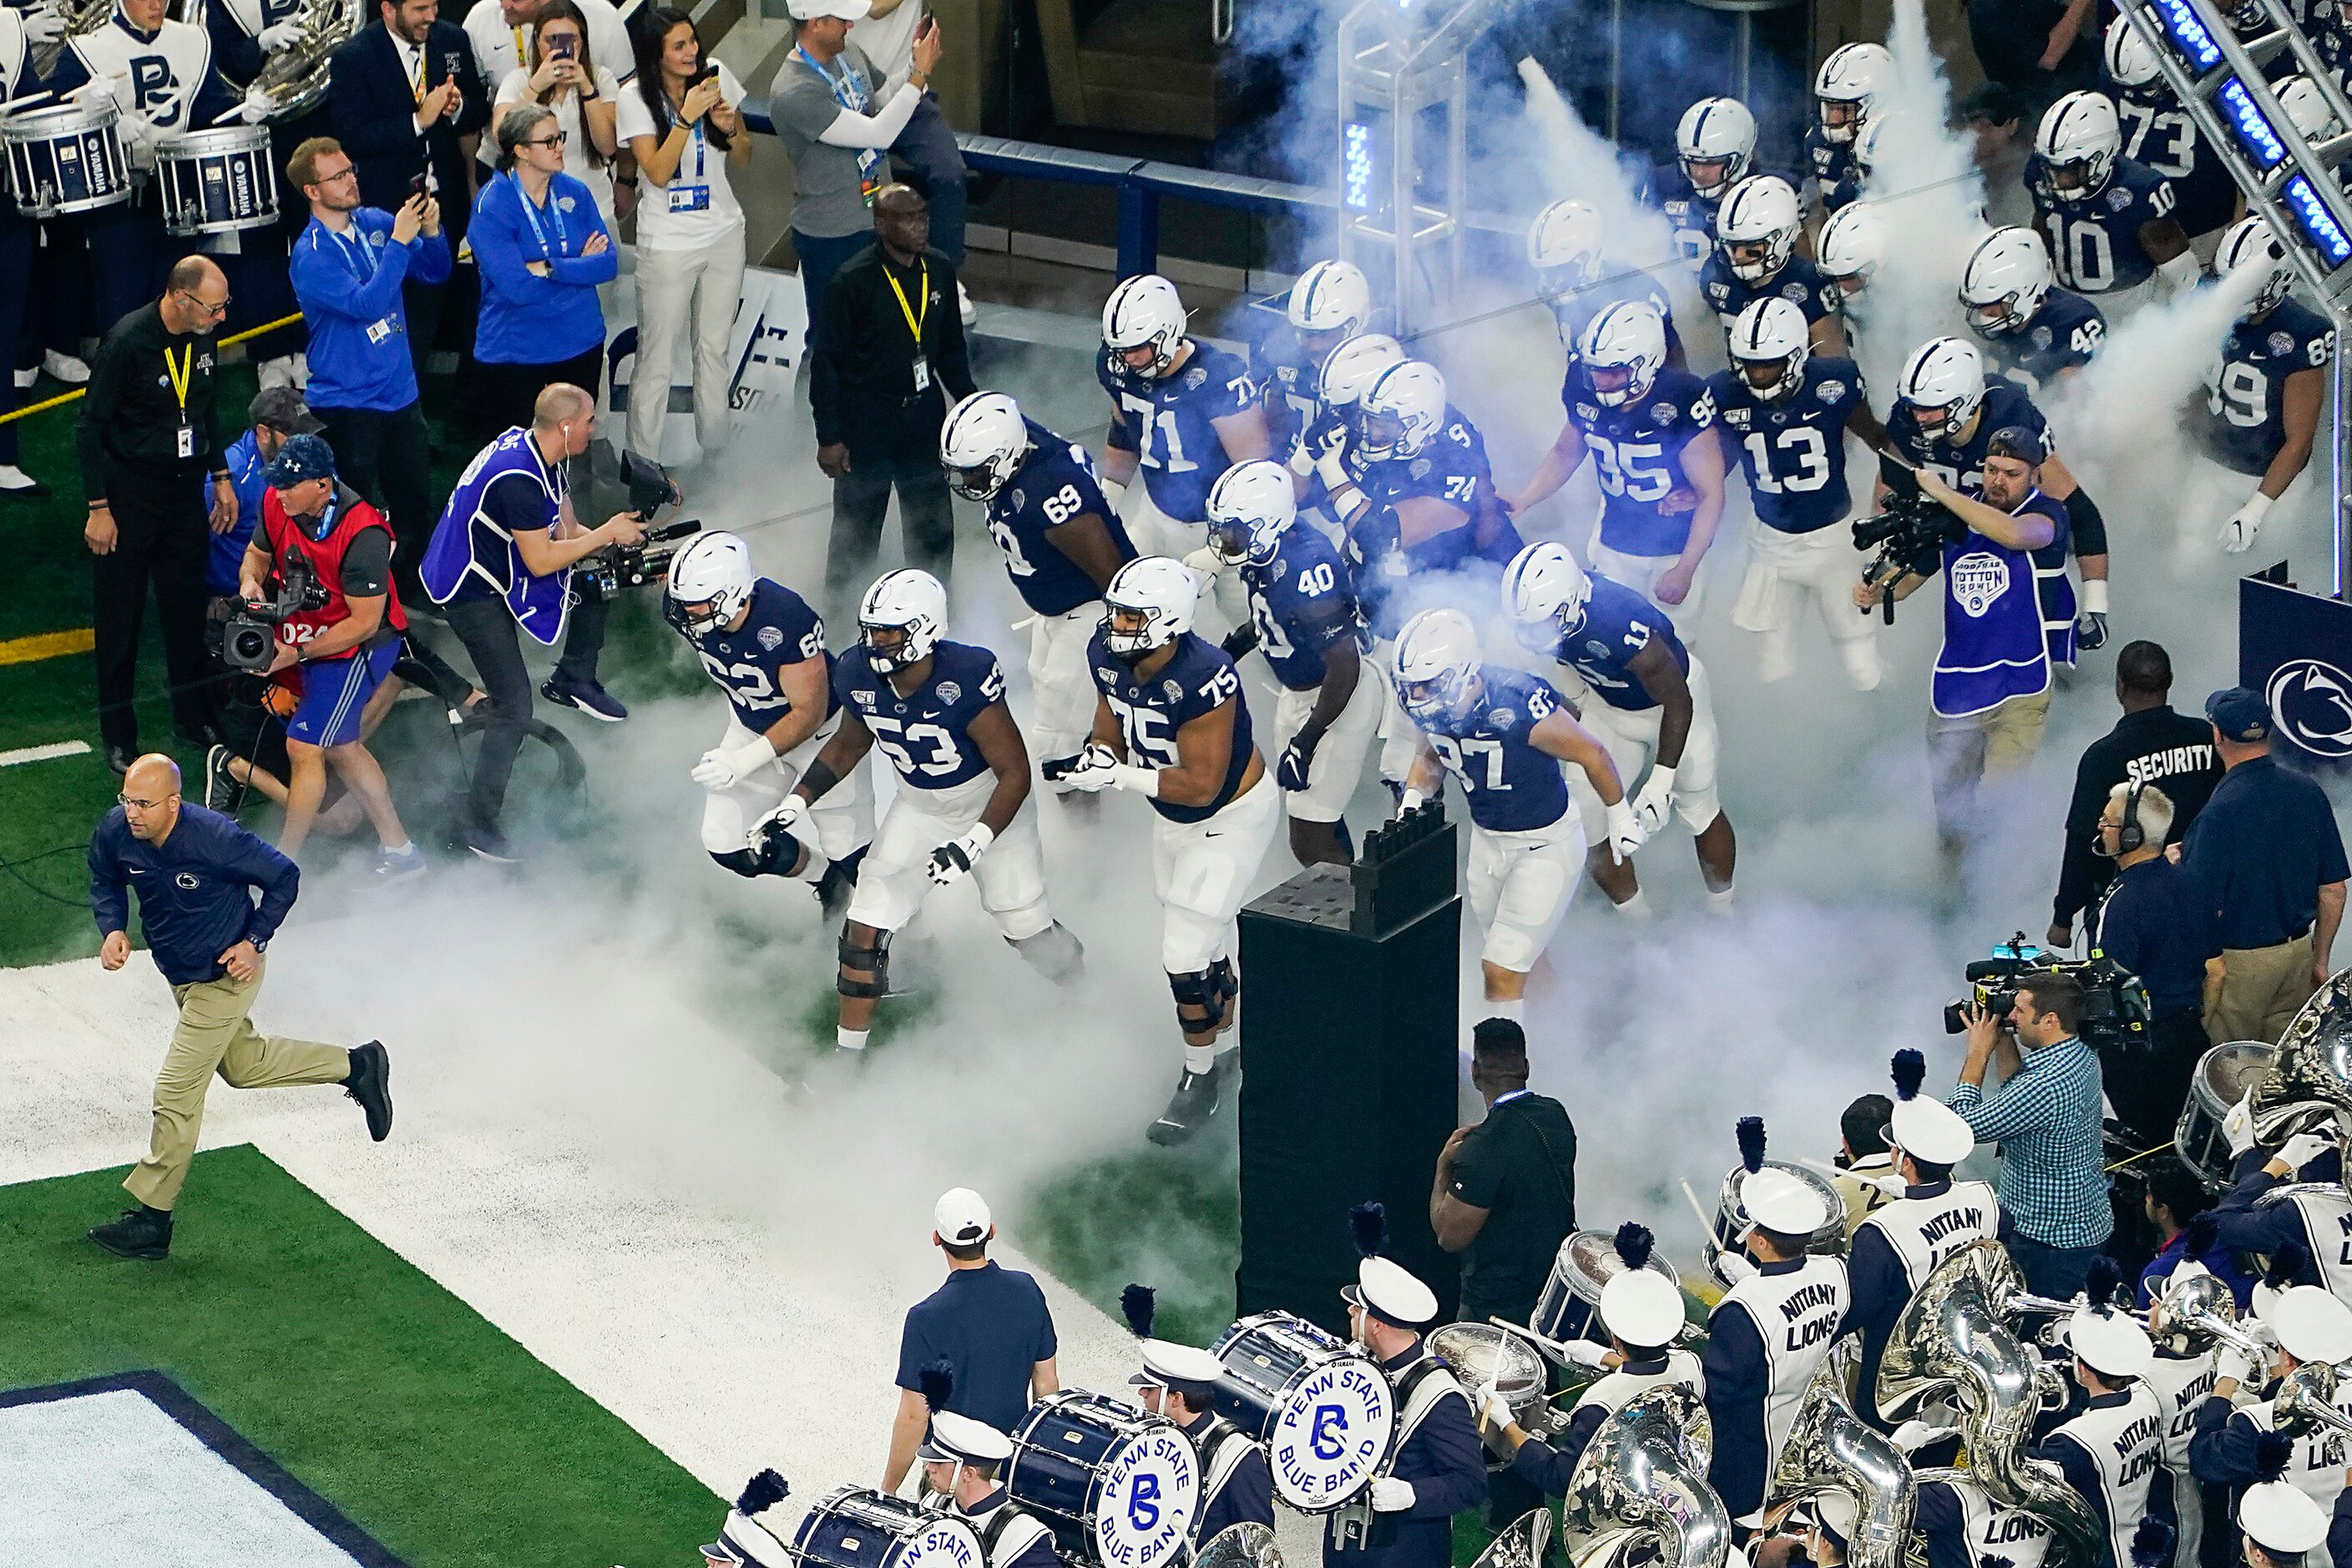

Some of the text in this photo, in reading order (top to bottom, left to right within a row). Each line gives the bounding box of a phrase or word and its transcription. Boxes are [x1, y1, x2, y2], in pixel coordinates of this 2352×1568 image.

[2119, 98, 2197, 178] 73
[90, 150, 108, 193] YAMAHA
[235, 172, 250, 215] YAMAHA
[2148, 180, 2177, 218] 10
[2046, 212, 2115, 291] 10
[2071, 319, 2106, 354] 42
[2306, 331, 2335, 366] 89
[1689, 387, 1718, 427] 95
[1120, 392, 1199, 473] 71
[1744, 426, 1830, 493] 13
[1043, 484, 1082, 524] 69
[1444, 476, 1476, 502] 74
[1297, 562, 1334, 598] 40
[1623, 620, 1651, 650] 11
[698, 650, 790, 711] 62
[1198, 664, 1237, 708] 75
[862, 715, 963, 776] 53
[1106, 695, 1182, 769] 75
[2127, 744, 2213, 783] SECURITY
[1860, 1182, 1887, 1211] 2
[1920, 1207, 1982, 1247] NITTANY
[1778, 1283, 1836, 1323] NITTANY
[1786, 1309, 1839, 1351] LIONS
[1284, 1370, 1382, 1428] PENN STATE
[2174, 1370, 2218, 1412] NITTAN
[1151, 1428, 1166, 1436] YAMAHA
[1105, 1438, 1190, 1499] PENN STATE
[1279, 1439, 1375, 1493] BLUE BAND
[1128, 1473, 1161, 1531] PS
[927, 1531, 972, 1568] STATE
[1101, 1516, 1134, 1565] BLUE
